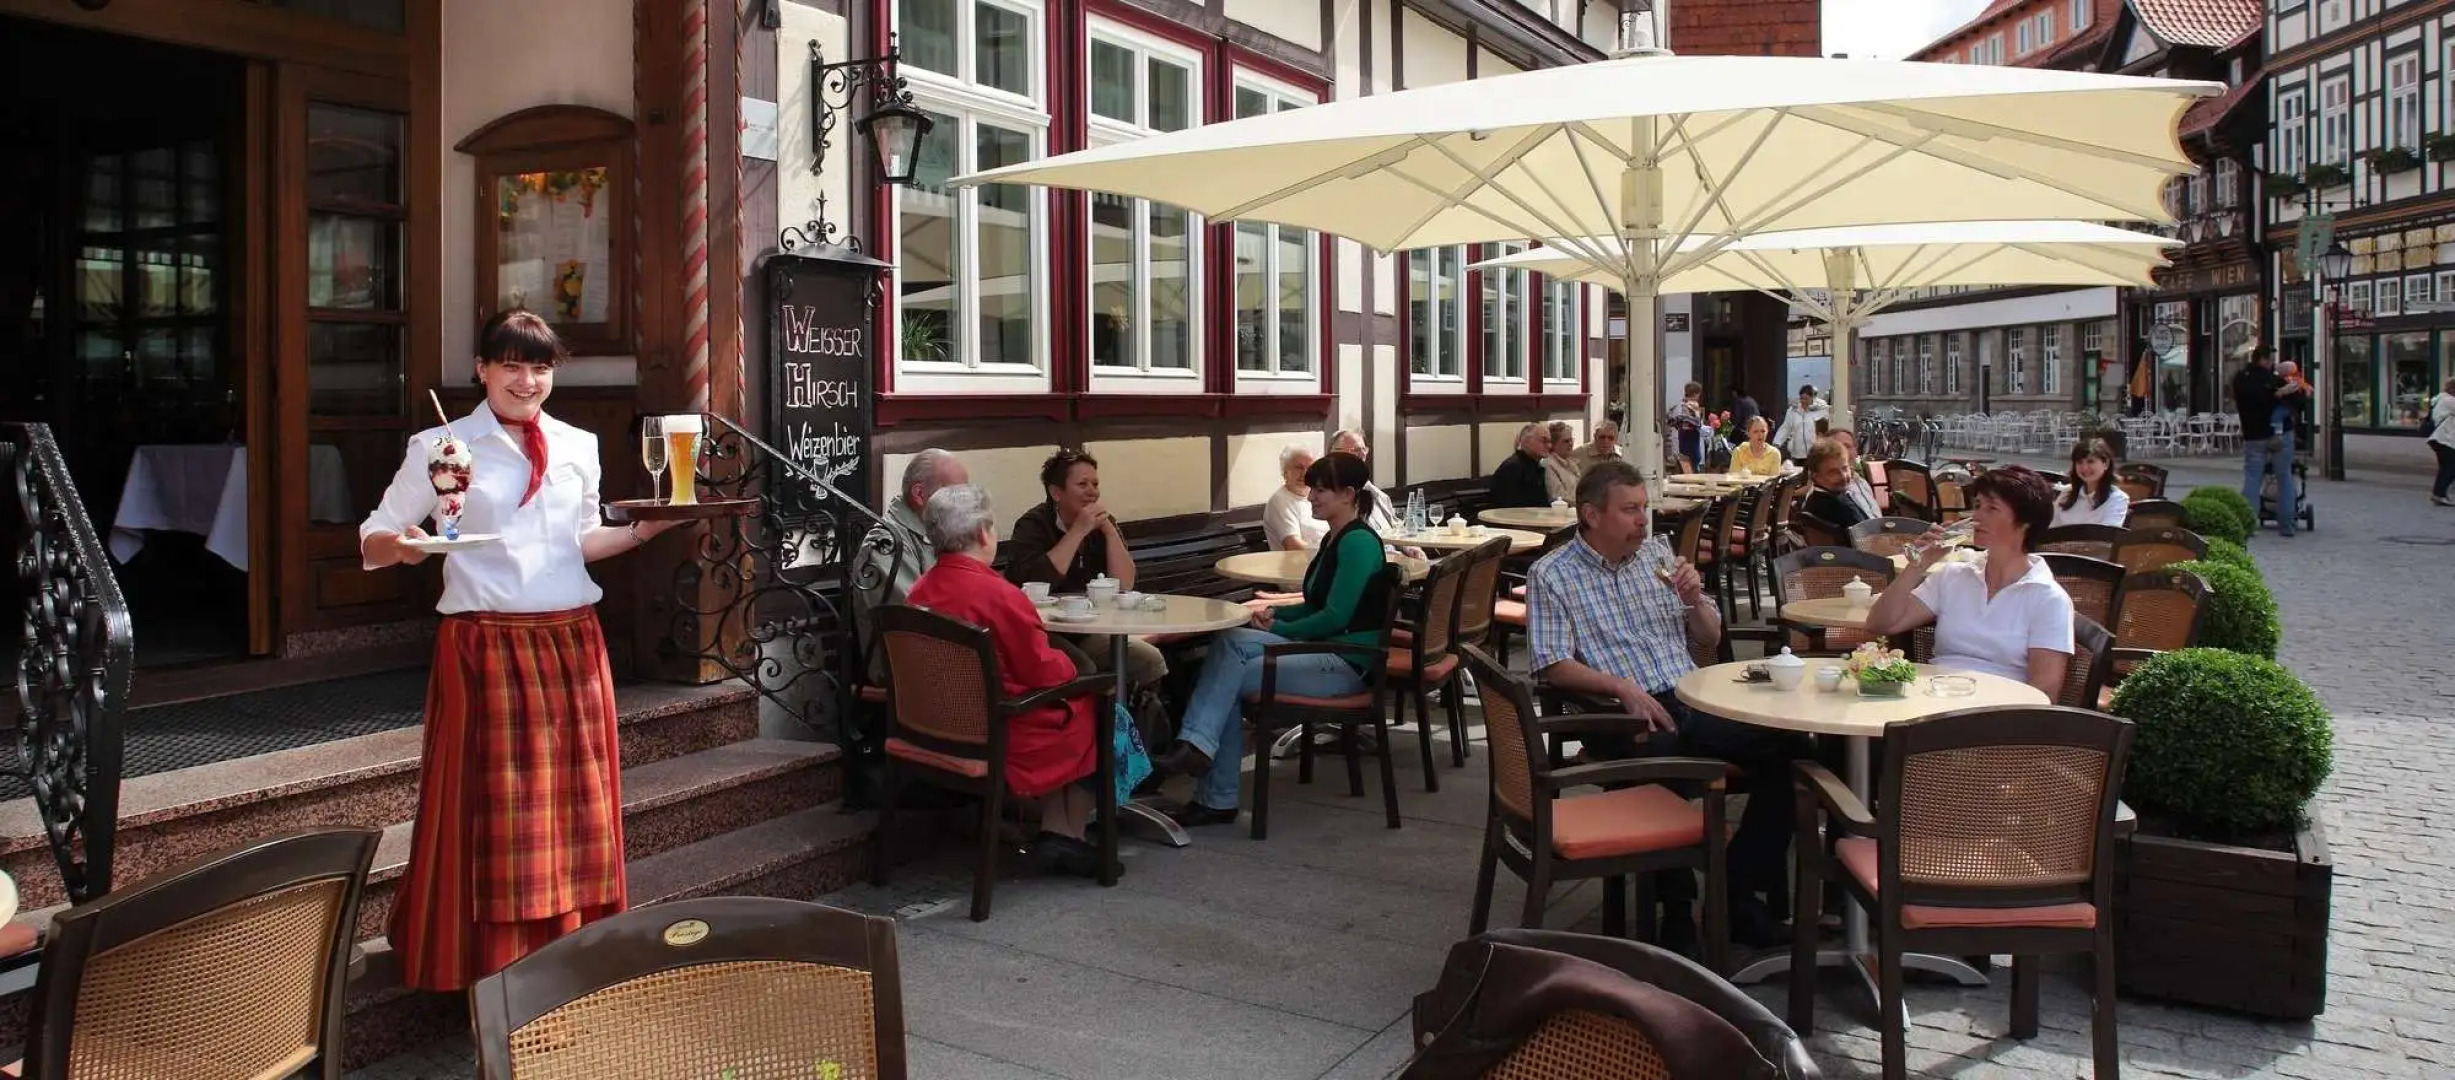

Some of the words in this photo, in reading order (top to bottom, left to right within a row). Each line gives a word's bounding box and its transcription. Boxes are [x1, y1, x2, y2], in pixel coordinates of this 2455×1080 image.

[2211, 264, 2246, 286] WIEN
[782, 304, 862, 358] WEISSER
[785, 362, 858, 409] HIRSCH
[787, 421, 861, 461] Weizenbier
